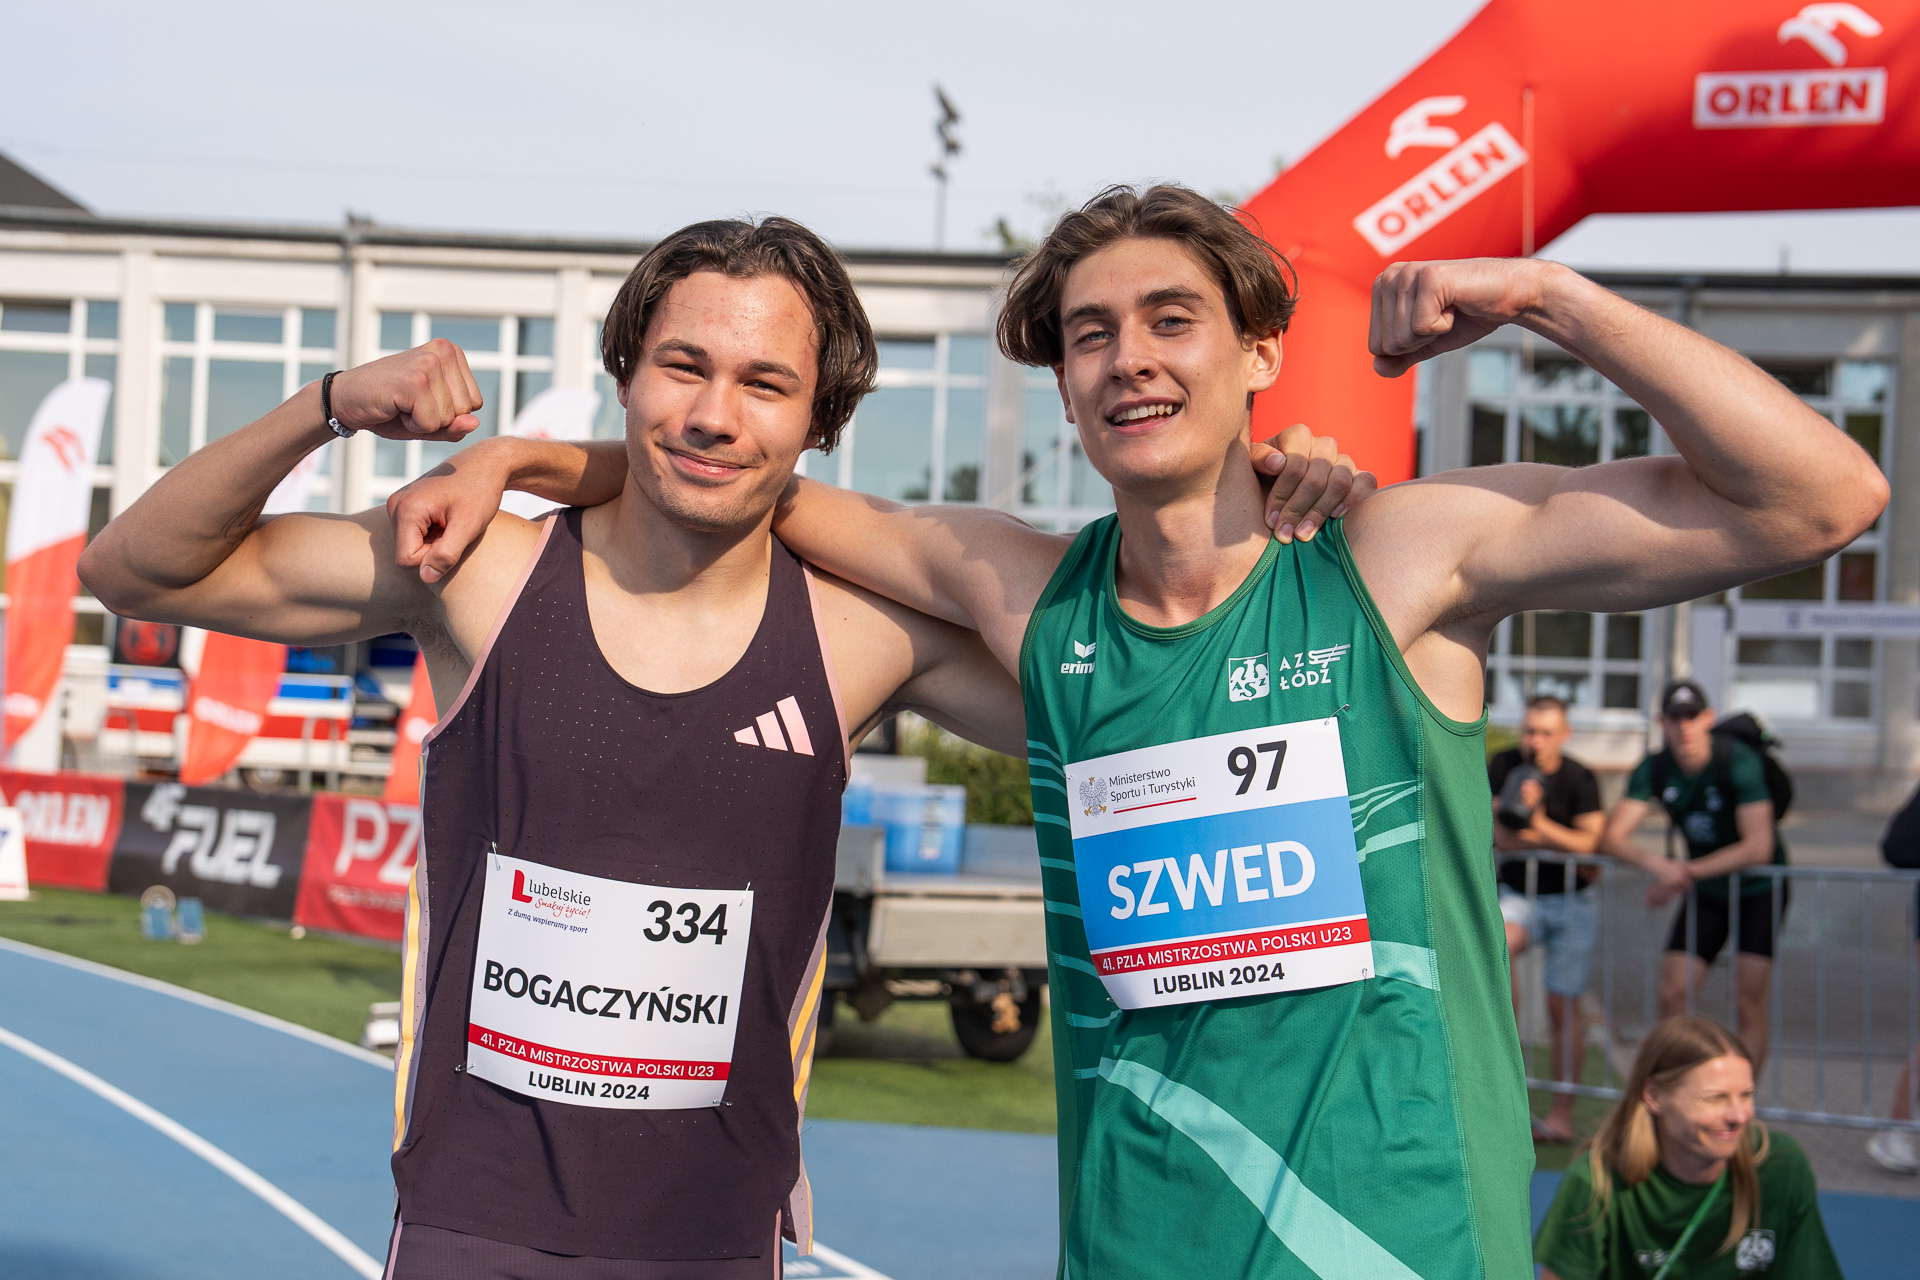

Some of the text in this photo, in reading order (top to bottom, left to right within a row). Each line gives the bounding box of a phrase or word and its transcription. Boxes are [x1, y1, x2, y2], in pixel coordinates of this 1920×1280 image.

[1708, 79, 1869, 117] ORLEN
[1377, 138, 1509, 238] ORLEN
[1280, 668, 1332, 690] ŁÓDŹ
[1109, 768, 1171, 787] Ministerstwo
[1227, 740, 1287, 796] 97
[1110, 777, 1196, 803] Sportu i Turystyki
[160, 803, 283, 890] FUEL
[1108, 840, 1315, 920] SZWED
[513, 910, 532, 922] dumą
[533, 916, 568, 931] wspieramy
[569, 925, 588, 934] sport
[535, 898, 591, 919] Smakuj życie!
[643, 900, 728, 945] 334
[1102, 926, 1352, 971] 41. PZLA MISTRZOSTWA POLSKI U23
[483, 959, 728, 1025] BOGACZYŃSKI
[1153, 962, 1285, 995] LUBLIN 2024
[480, 1032, 714, 1078] 41. PZLA MISTRZOSTWA POLSKI U23
[528, 1071, 650, 1100] LUBLIN 2024
